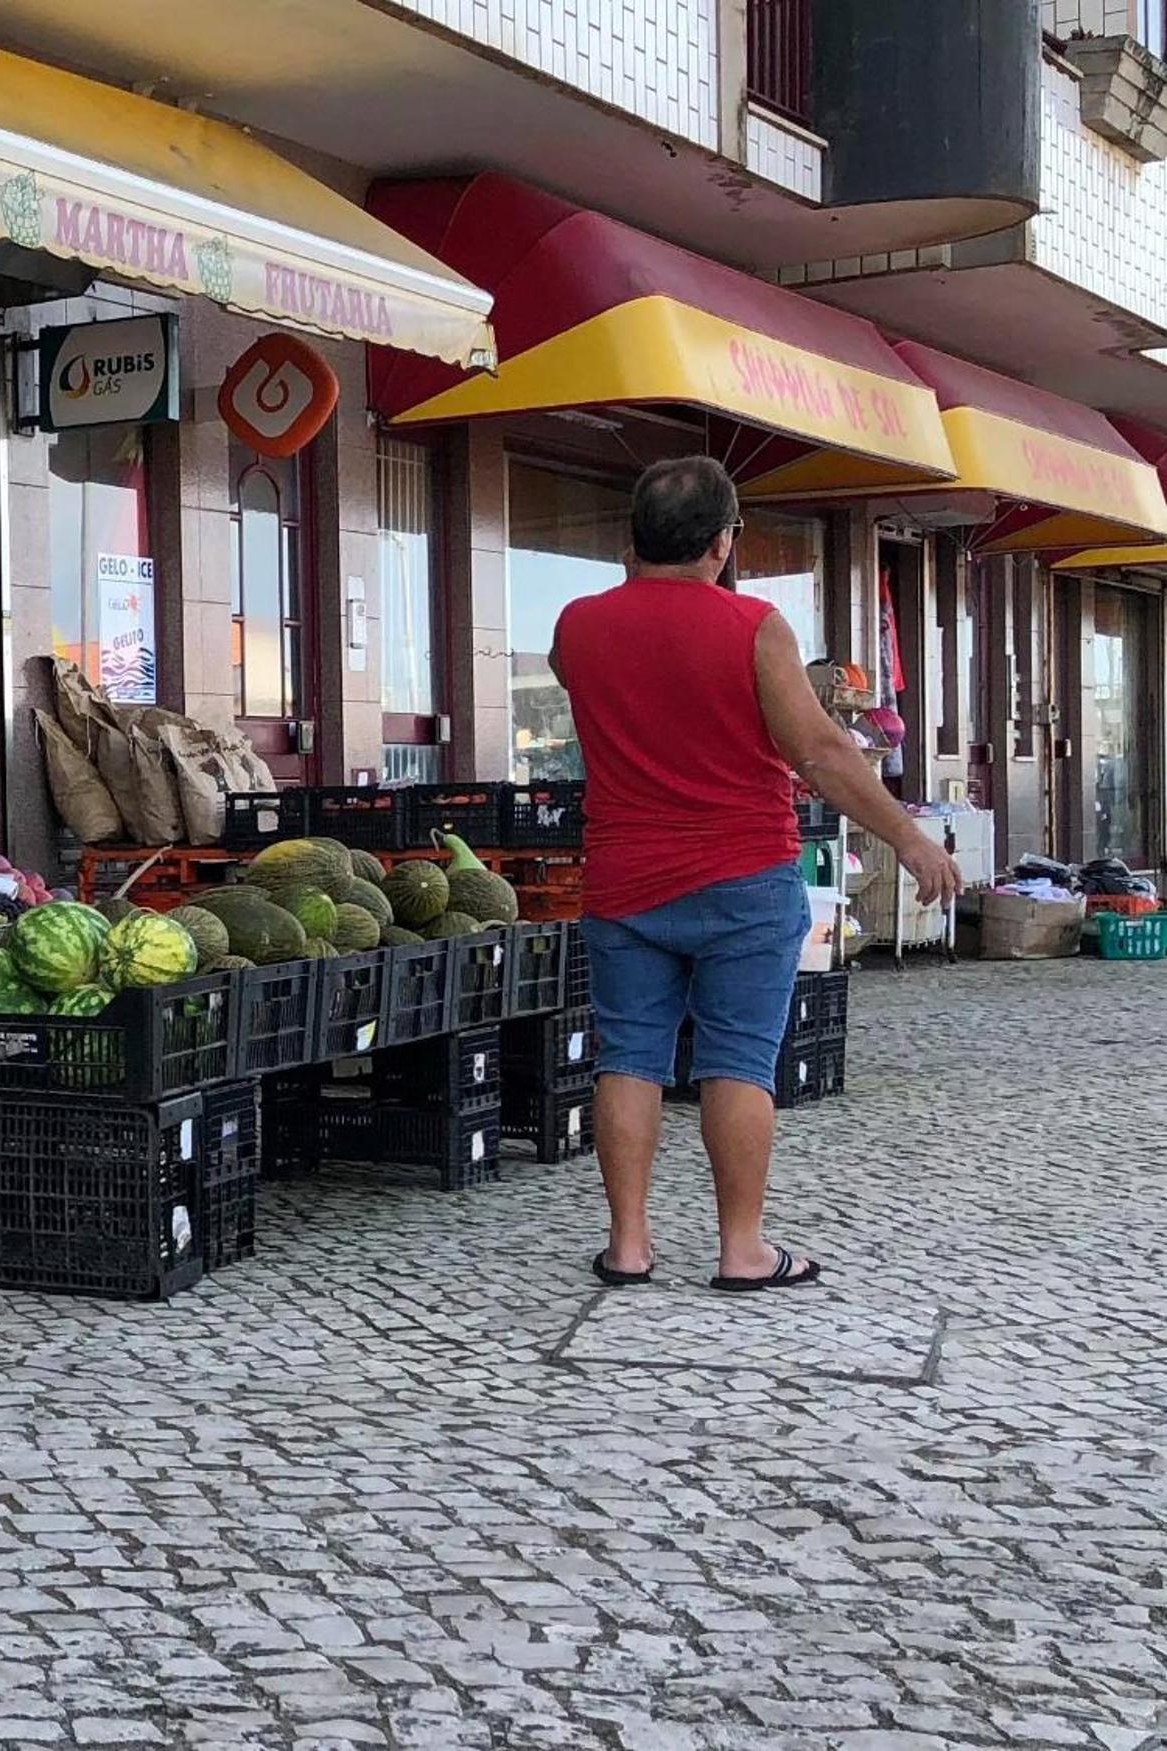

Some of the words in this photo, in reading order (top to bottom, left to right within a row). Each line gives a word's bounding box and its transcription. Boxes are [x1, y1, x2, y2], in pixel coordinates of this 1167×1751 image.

[55, 197, 189, 281] MARTHA
[264, 261, 394, 337] FRUTARIA
[99, 557, 128, 576] GELO
[137, 560, 153, 578] ICE
